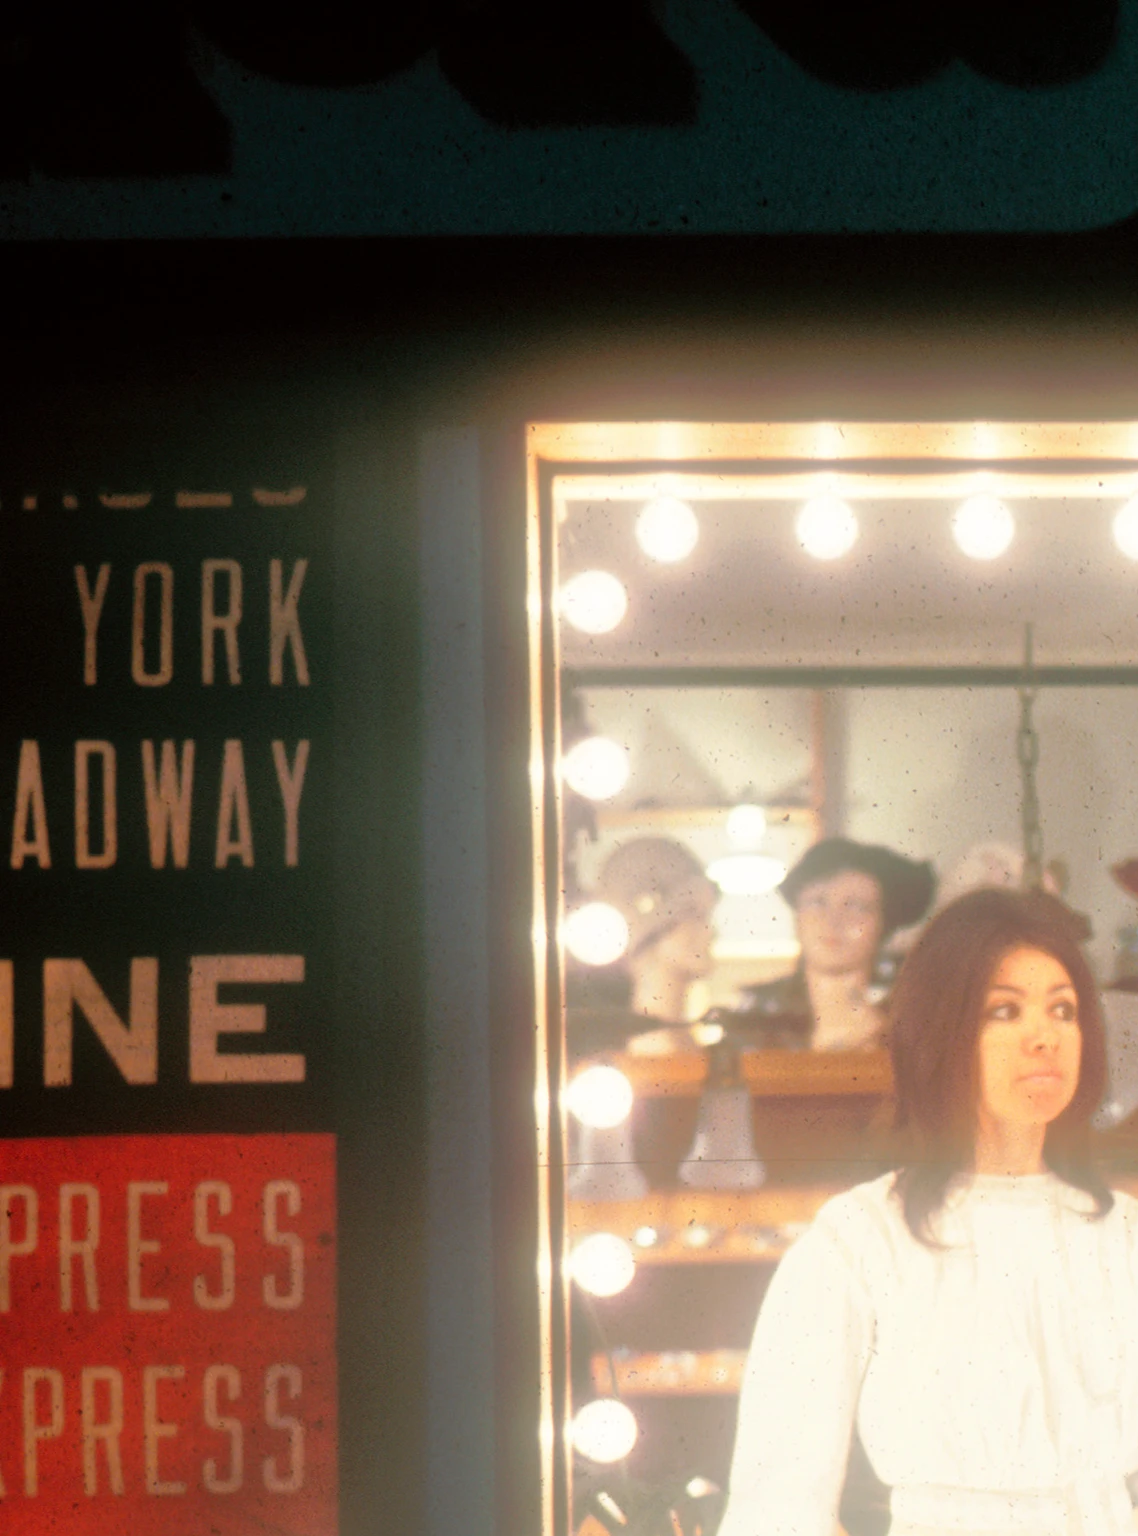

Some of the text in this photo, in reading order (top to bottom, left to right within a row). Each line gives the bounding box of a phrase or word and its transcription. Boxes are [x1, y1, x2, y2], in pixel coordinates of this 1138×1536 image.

[74, 559, 310, 687] YORK
[10, 739, 310, 870] ADWAY
[0, 1364, 306, 1498] PRESS
